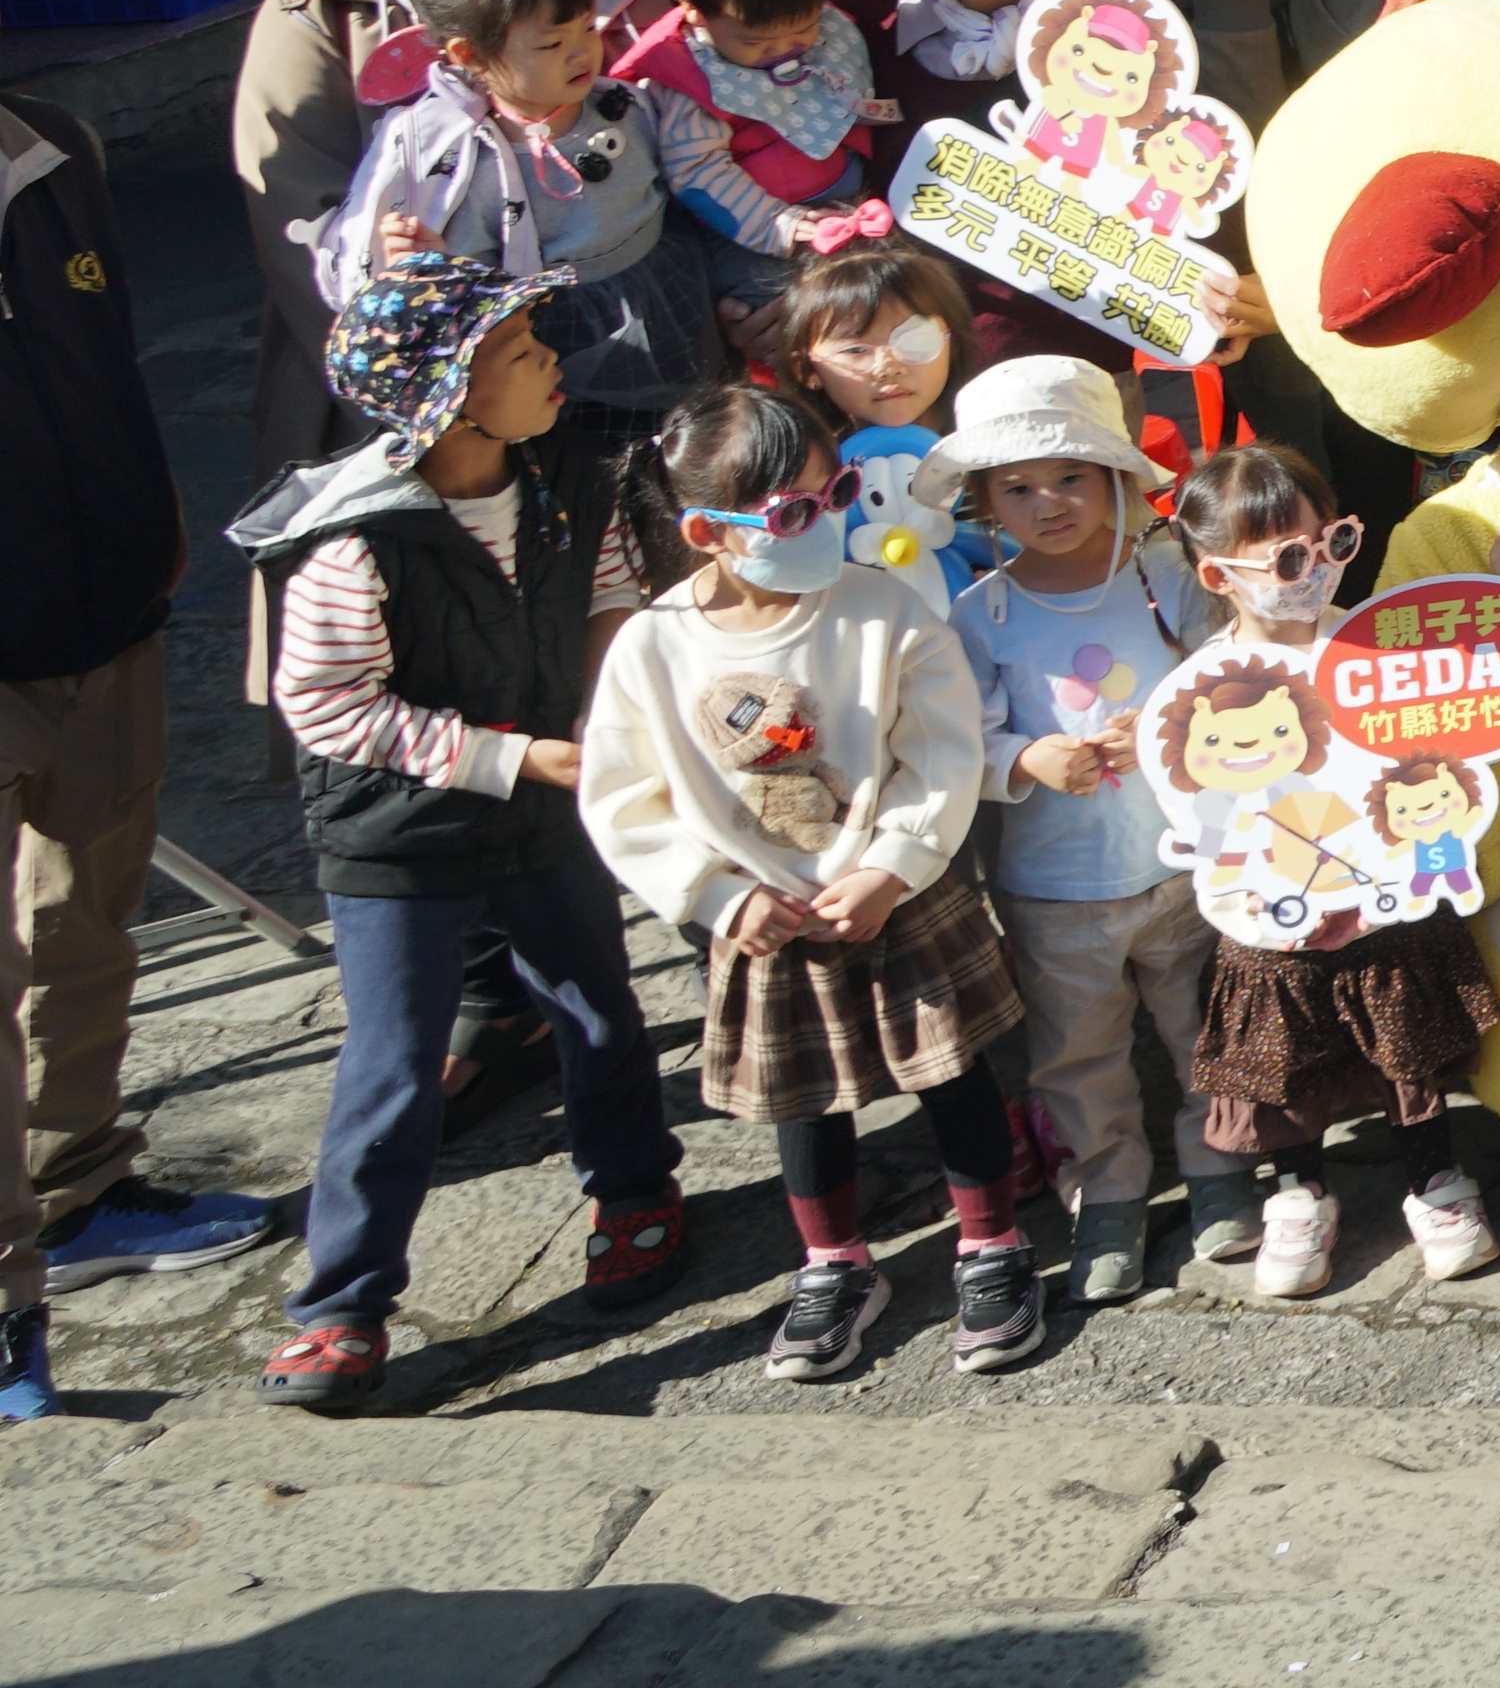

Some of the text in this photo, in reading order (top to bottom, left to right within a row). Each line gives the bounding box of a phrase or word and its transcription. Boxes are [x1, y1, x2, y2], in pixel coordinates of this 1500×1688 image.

[910, 183, 1194, 357] 多元 平等 共融
[927, 134, 1206, 310] 消除無意識偏見
